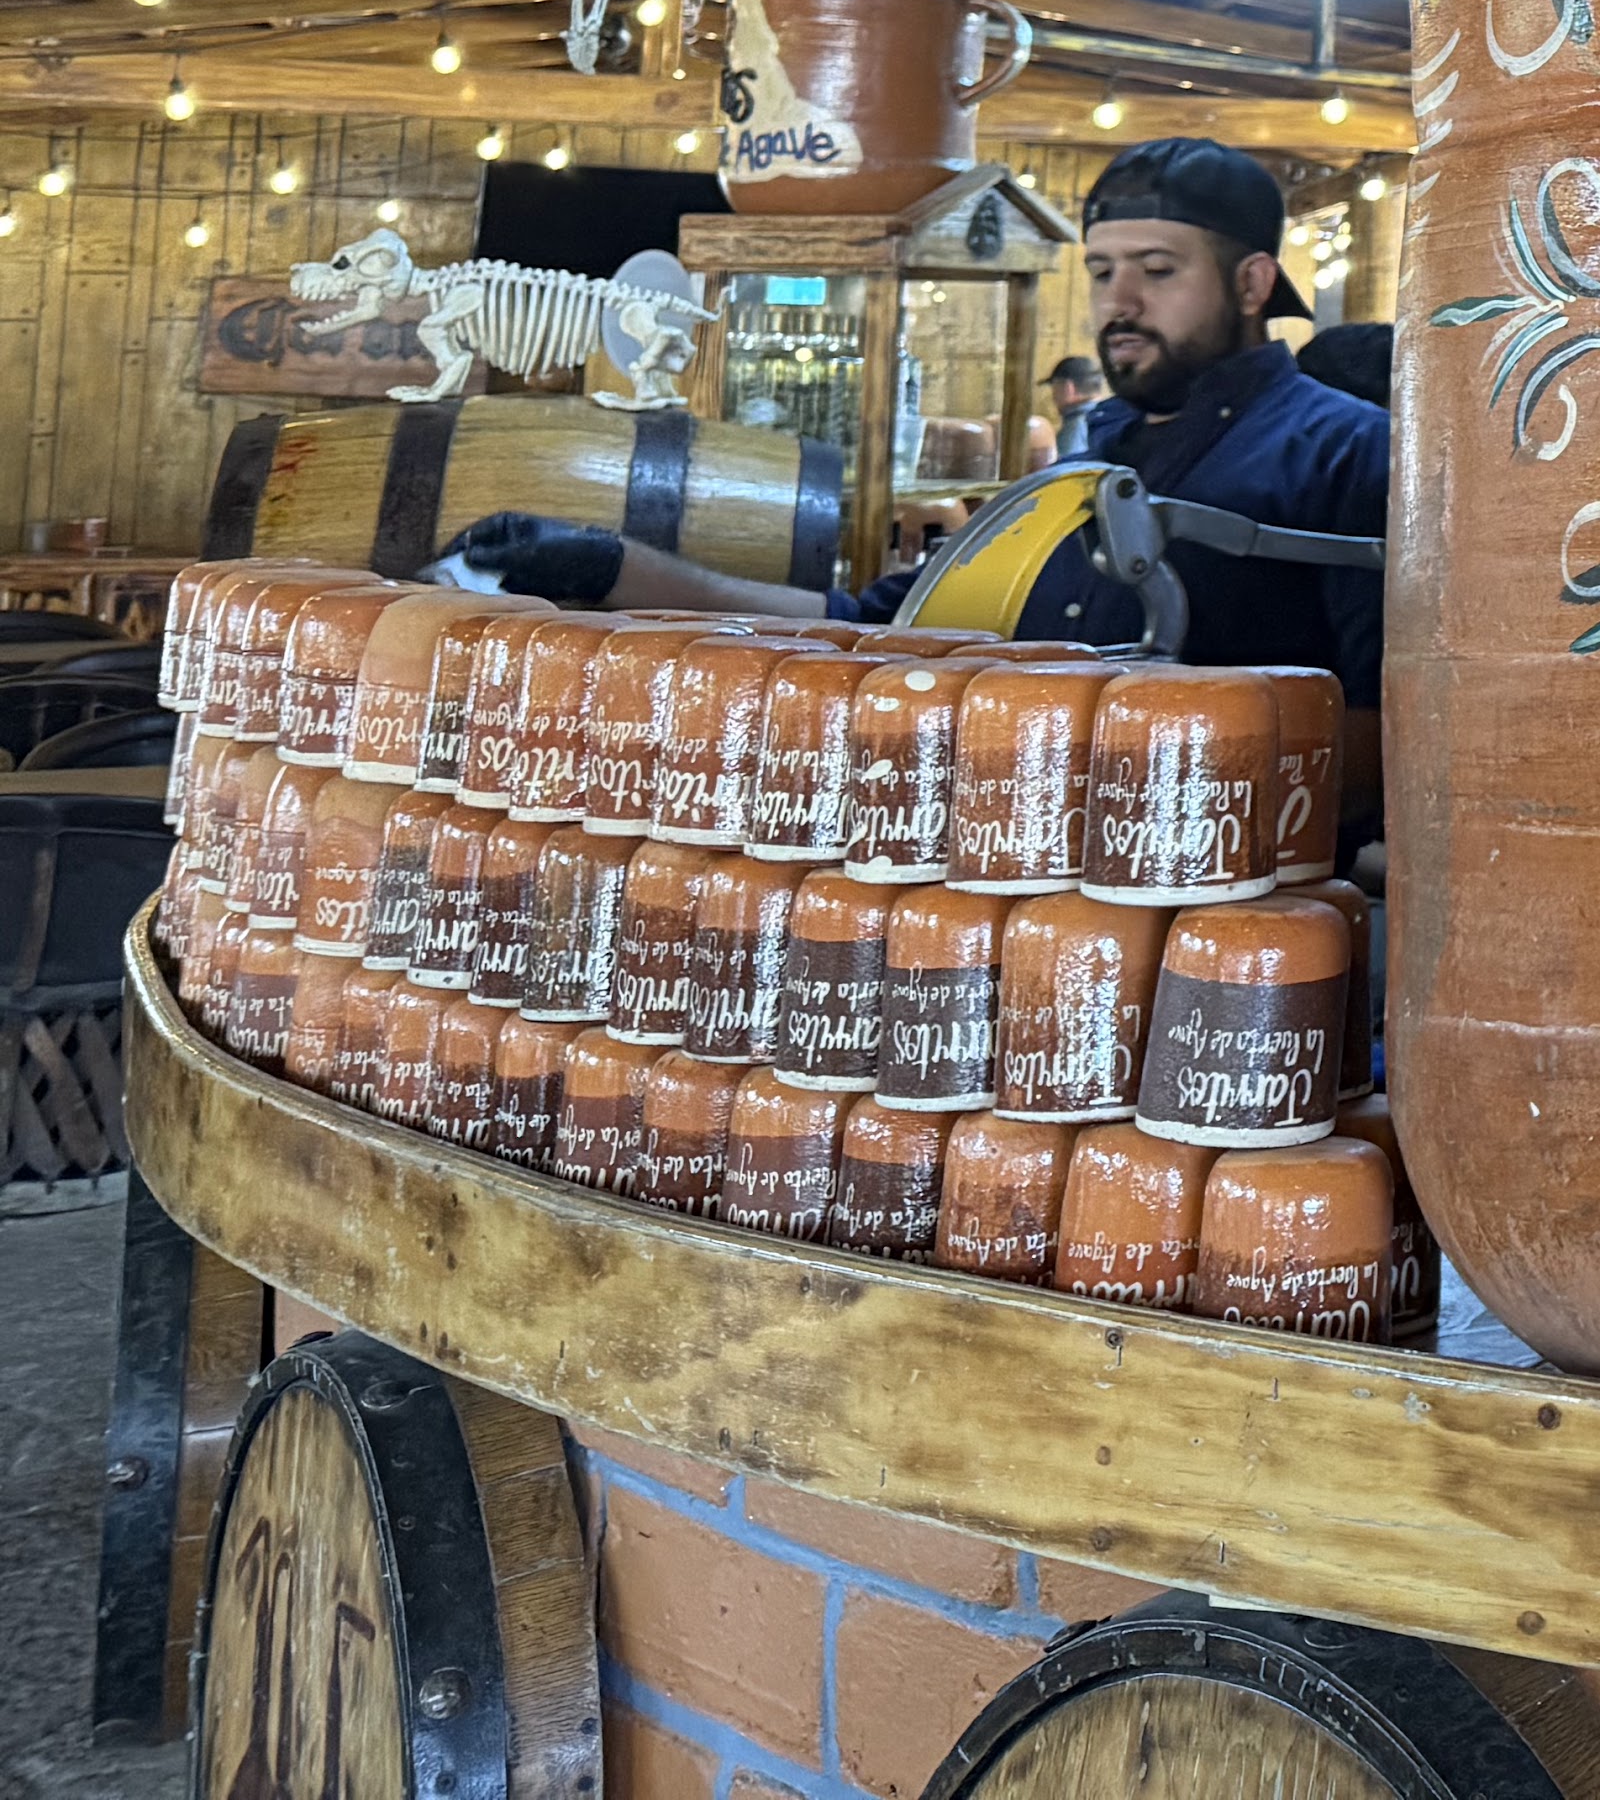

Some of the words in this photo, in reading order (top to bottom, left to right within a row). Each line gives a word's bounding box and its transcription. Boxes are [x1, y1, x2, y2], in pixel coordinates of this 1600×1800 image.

[815, 981, 830, 1004] de
[931, 985, 950, 1007] de
[788, 1010, 881, 1069] arritos
[892, 1020, 998, 1080] arritos
[1211, 1028, 1233, 1059] de
[1237, 1028, 1300, 1067] Puerta
[1178, 1066, 1312, 1126] Jarritos
[761, 1171, 779, 1195] de
[1125, 1243, 1152, 1271] de
[1226, 1246, 1276, 1303] Agave
[1307, 1265, 1358, 1305] Puerta
